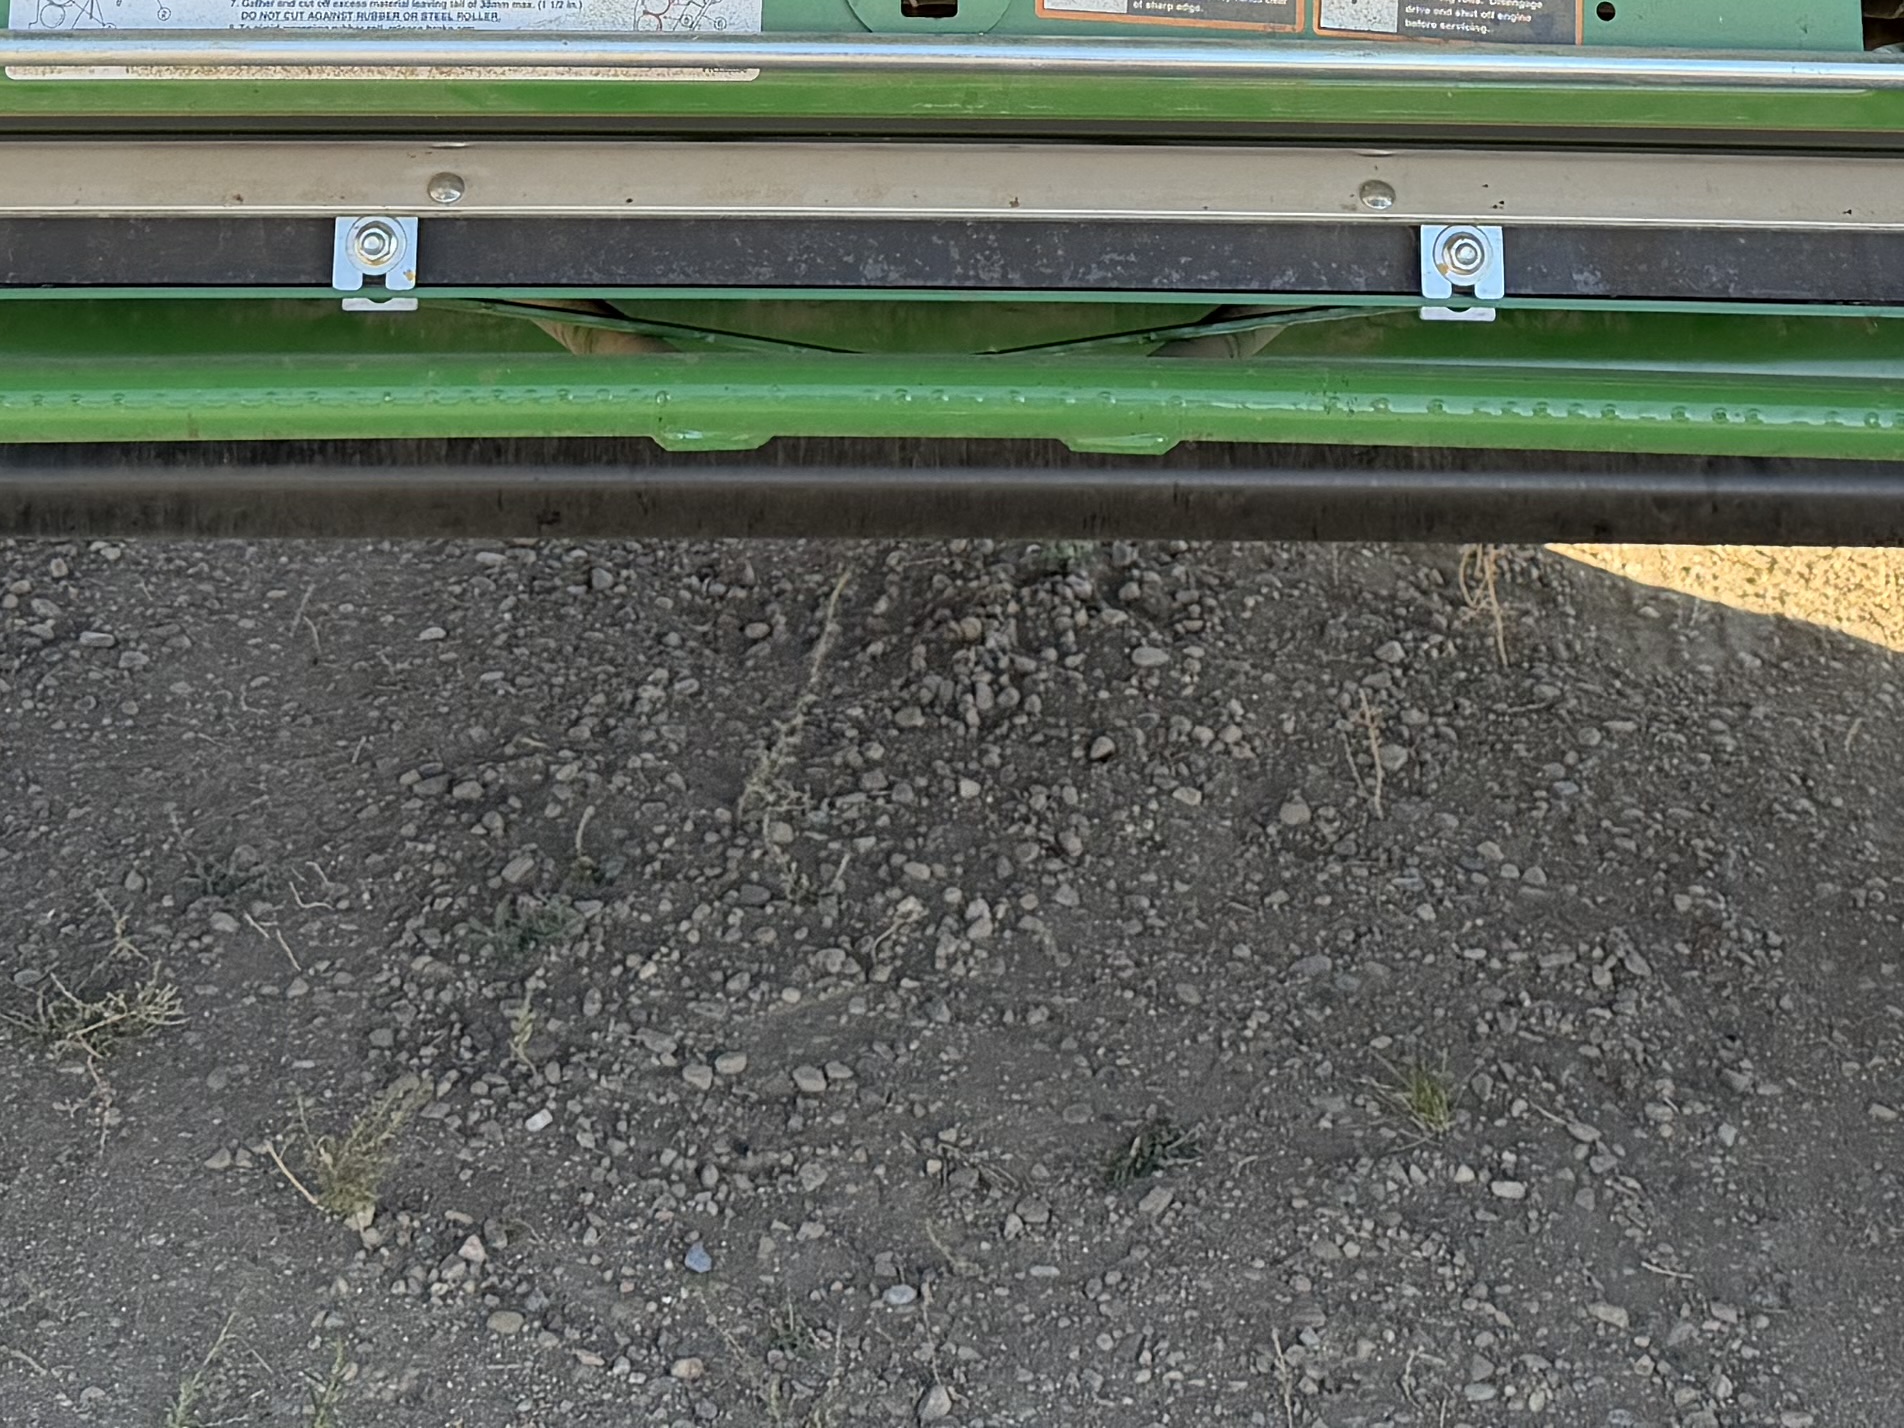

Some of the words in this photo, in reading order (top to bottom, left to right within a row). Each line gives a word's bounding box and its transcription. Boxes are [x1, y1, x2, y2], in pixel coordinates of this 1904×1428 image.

[298, 0, 314, 8] cut
[370, 0, 409, 8] material
[412, 0, 447, 10] leaving
[550, 0, 564, 8] 1/2
[1133, 1, 1143, 9] of
[1146, 2, 1173, 11] sharp
[258, 12, 280, 21] NOT
[283, 12, 304, 21] CUT
[307, 12, 353, 21] AGAINST
[356, 12, 400, 21] RUBBER
[420, 12, 453, 21] STEEL
[1406, 6, 1430, 15] drive
[1433, 7, 1452, 16] and
[1455, 8, 1478, 18] shut
[1481, 11, 1494, 19] off
[1497, 13, 1531, 23] engine
[1405, 19, 1437, 29] before
